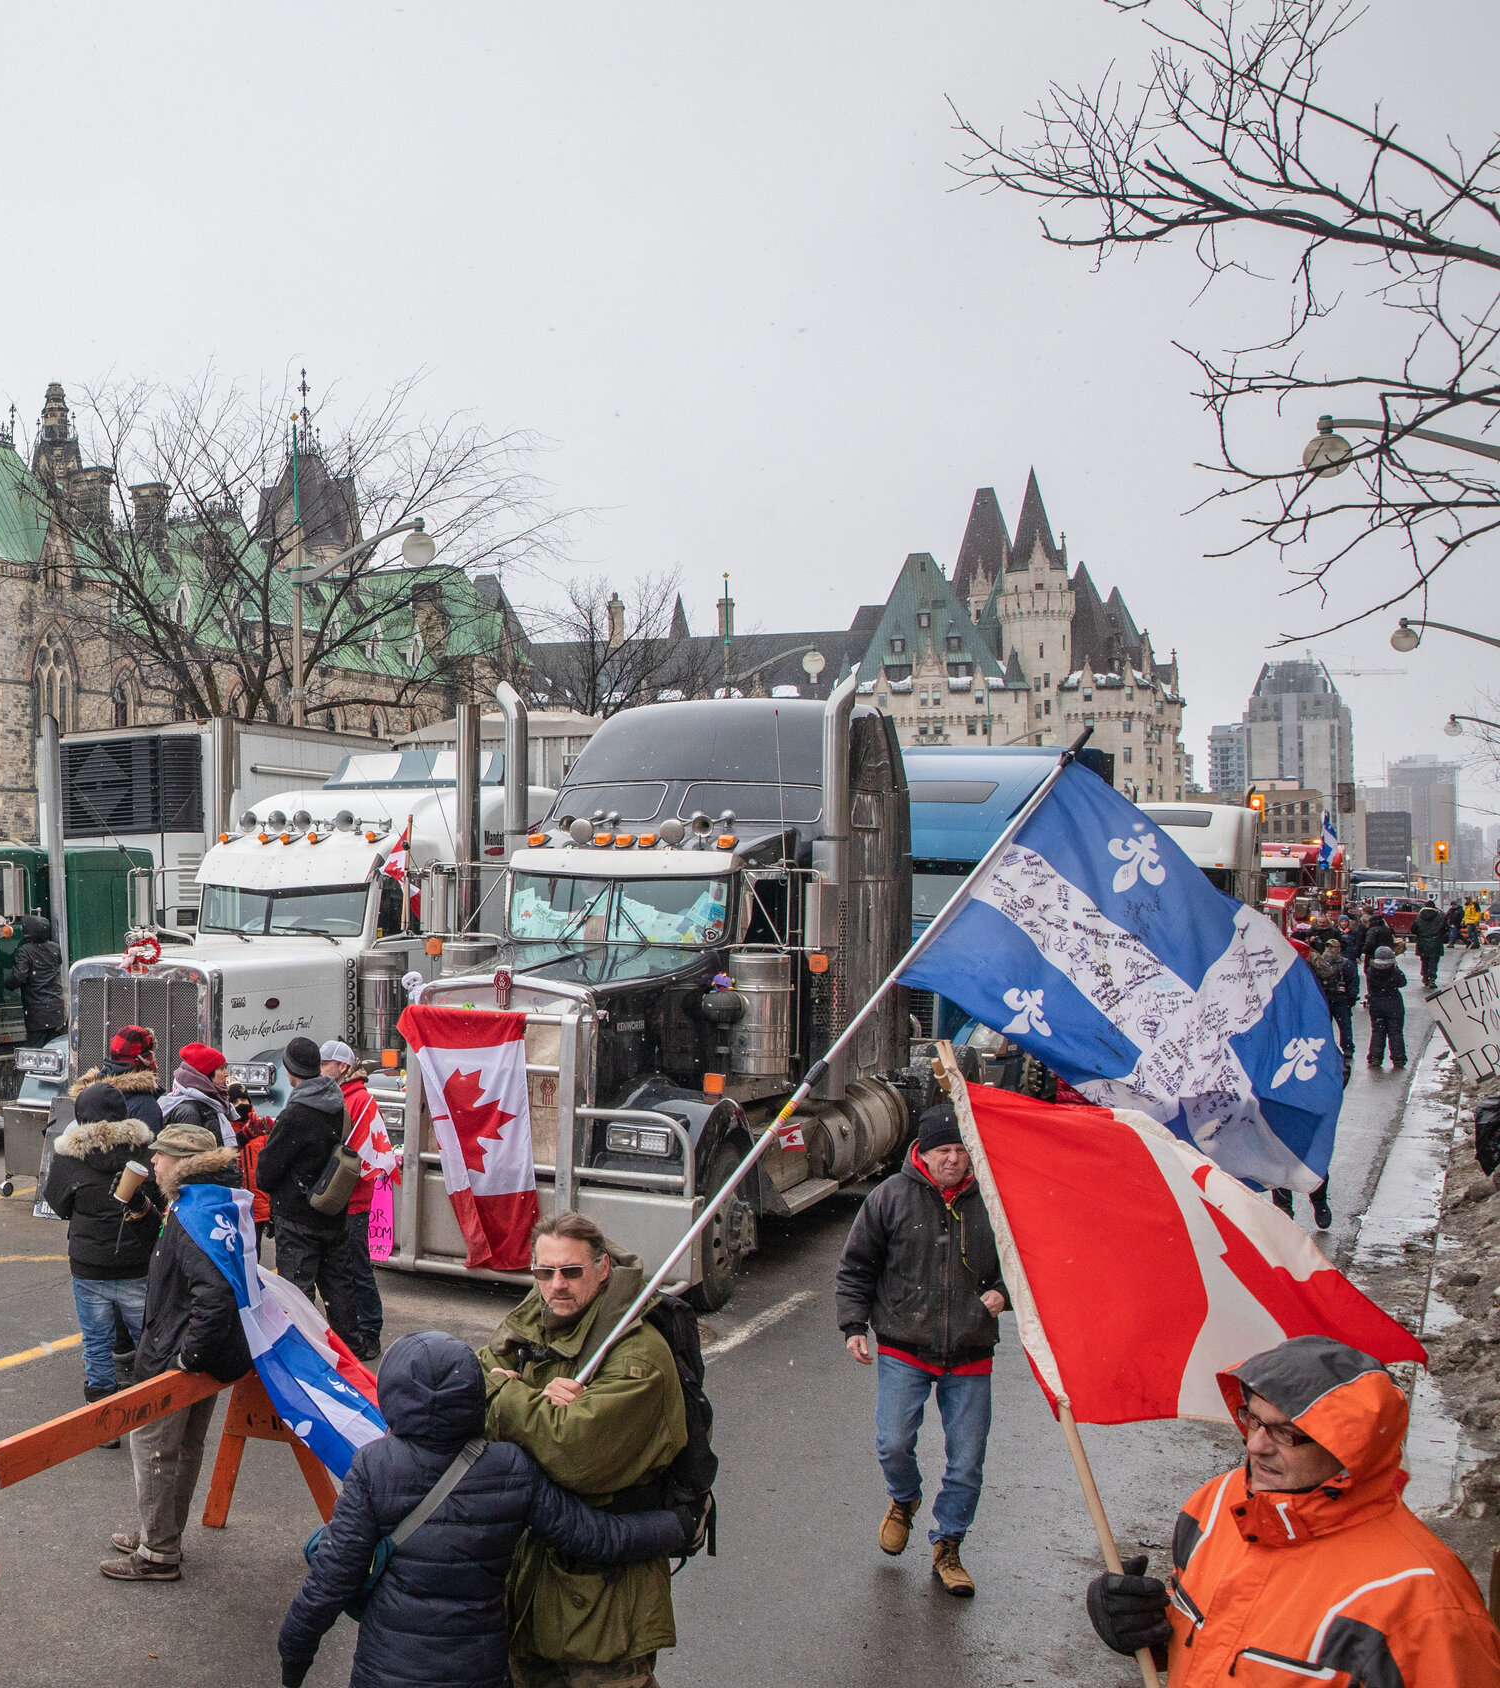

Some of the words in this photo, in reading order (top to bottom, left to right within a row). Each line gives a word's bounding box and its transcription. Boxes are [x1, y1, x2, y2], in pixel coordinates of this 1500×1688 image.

[228, 1024, 251, 1040] Rolling
[251, 1025, 257, 1035] to
[258, 1020, 271, 1037] Keep
[272, 1020, 294, 1033] Canada
[295, 1015, 313, 1031] Free!
[616, 1019, 645, 1032] KENWORTH
[1467, 1008, 1500, 1034] YO
[368, 1226, 392, 1240] DOM
